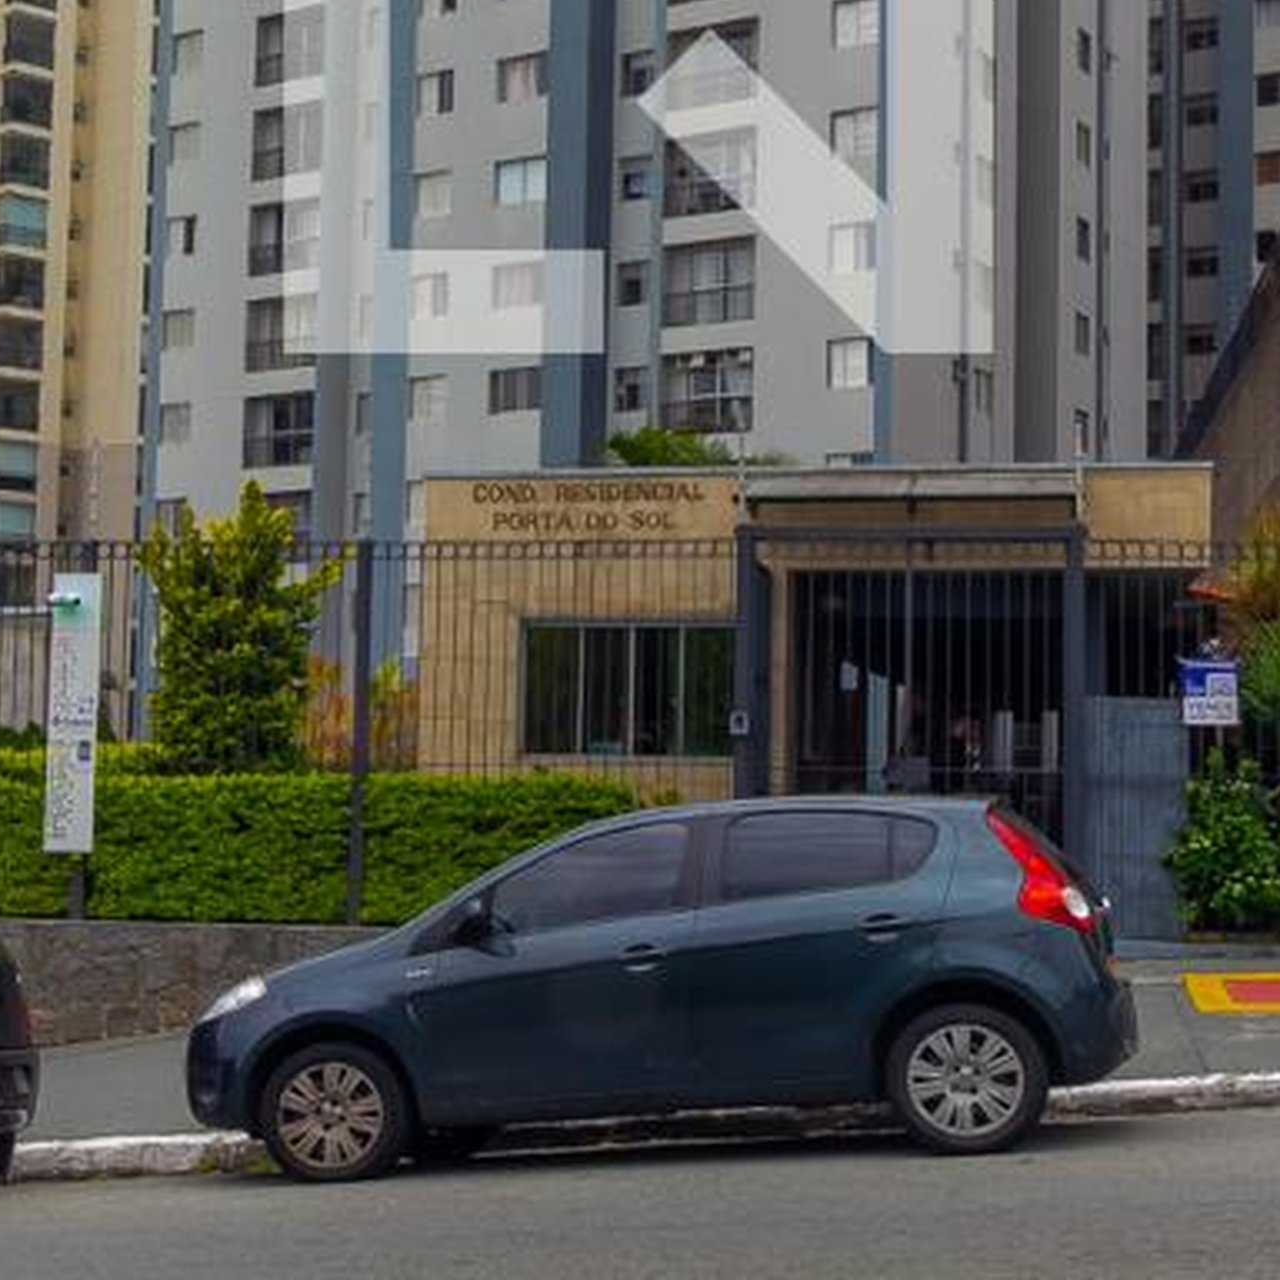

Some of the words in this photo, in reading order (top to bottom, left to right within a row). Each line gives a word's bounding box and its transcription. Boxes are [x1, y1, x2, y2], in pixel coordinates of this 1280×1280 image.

[556, 483, 704, 503] RESIDENCIAL
[492, 511, 576, 533] PORTA
[586, 511, 618, 531] DO
[630, 509, 676, 532] SOL
